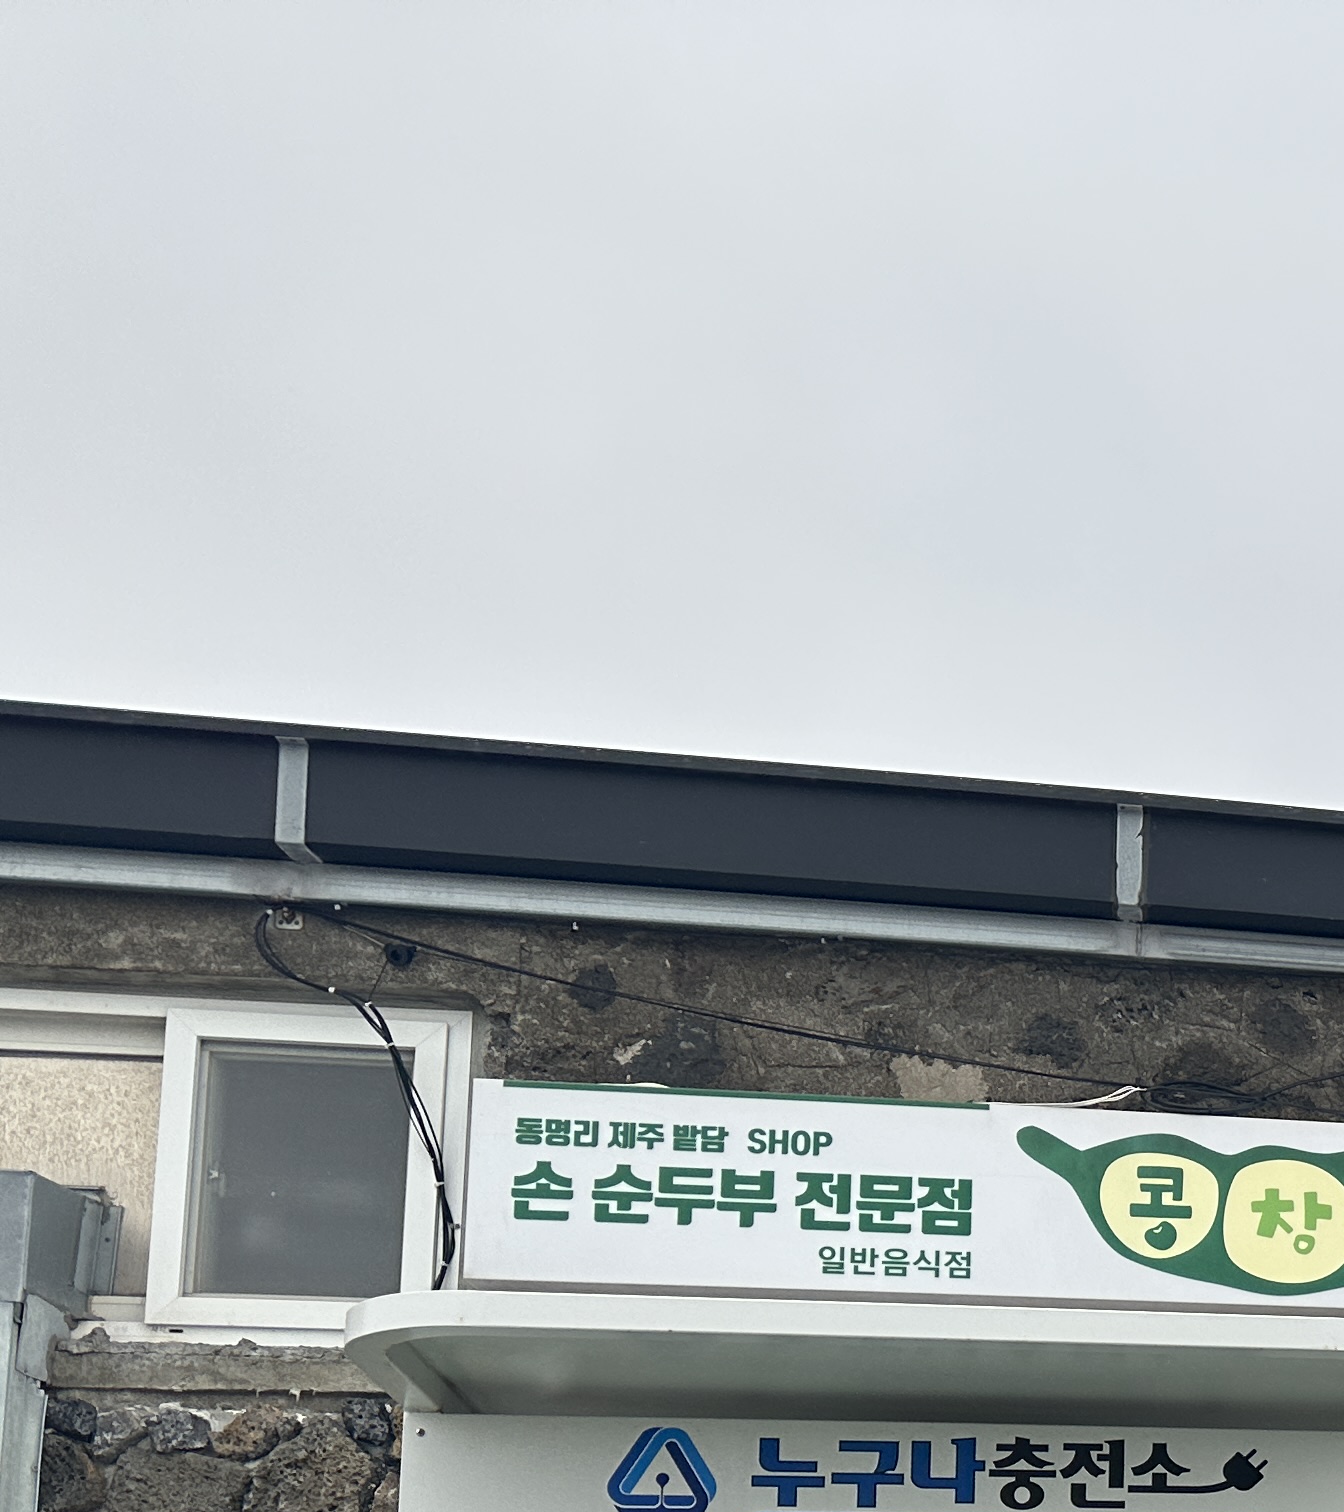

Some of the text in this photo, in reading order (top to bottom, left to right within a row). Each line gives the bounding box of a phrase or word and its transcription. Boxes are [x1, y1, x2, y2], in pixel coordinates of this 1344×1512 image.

[514, 1117, 833, 1156] 동명리 제주 밭담 SHOP
[510, 1160, 973, 1236] 손 순두부 전문점
[818, 1246, 972, 1279] 일반음식점
